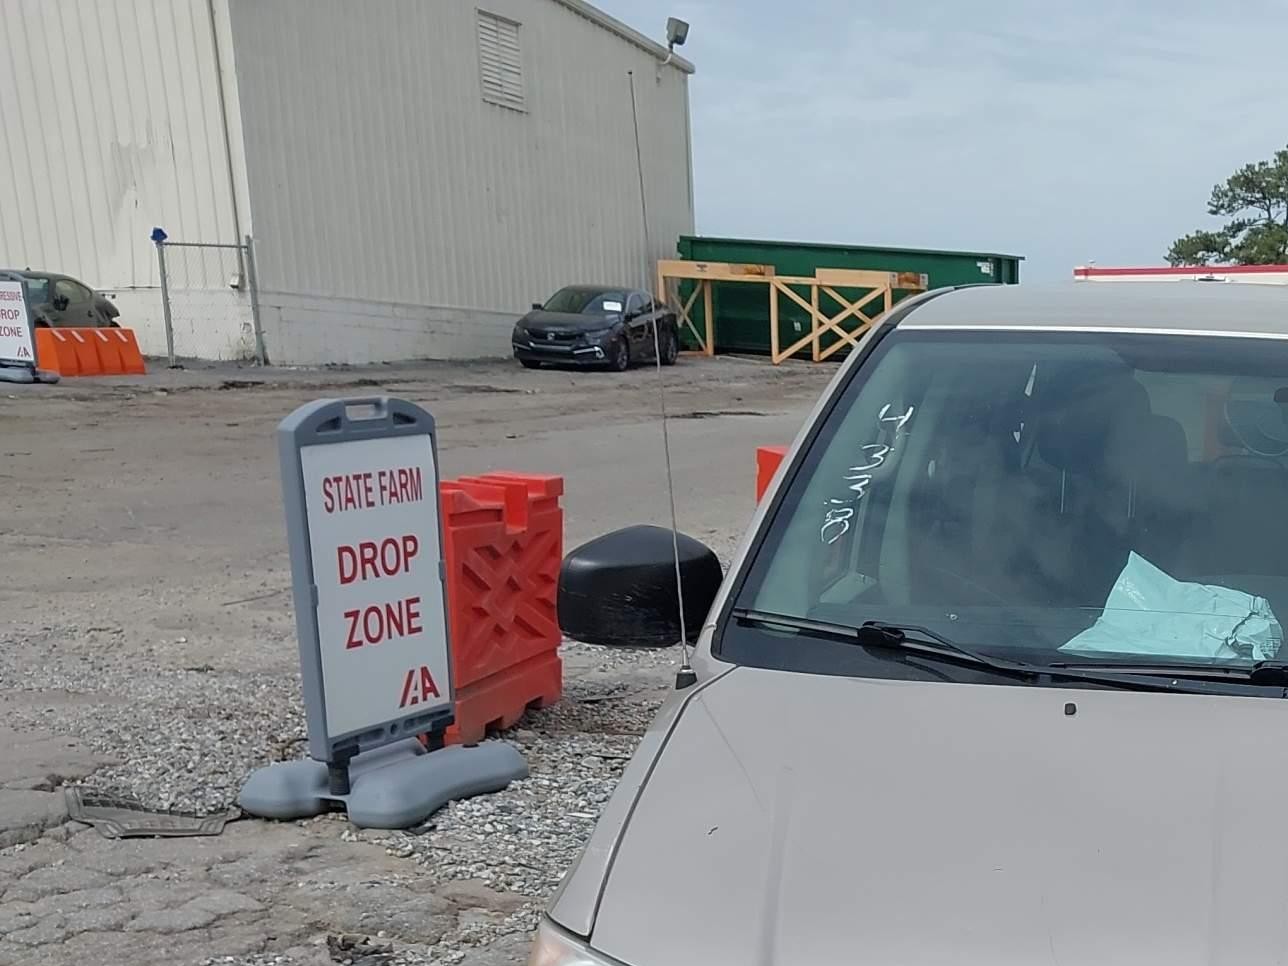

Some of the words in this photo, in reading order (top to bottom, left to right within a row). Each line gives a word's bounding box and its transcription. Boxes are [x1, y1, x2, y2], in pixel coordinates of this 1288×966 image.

[0, 308, 20, 320] ROP
[322, 472, 375, 514] STATE
[378, 467, 423, 506] FARM
[337, 534, 419, 585] DROP
[344, 597, 423, 649] ZONE
